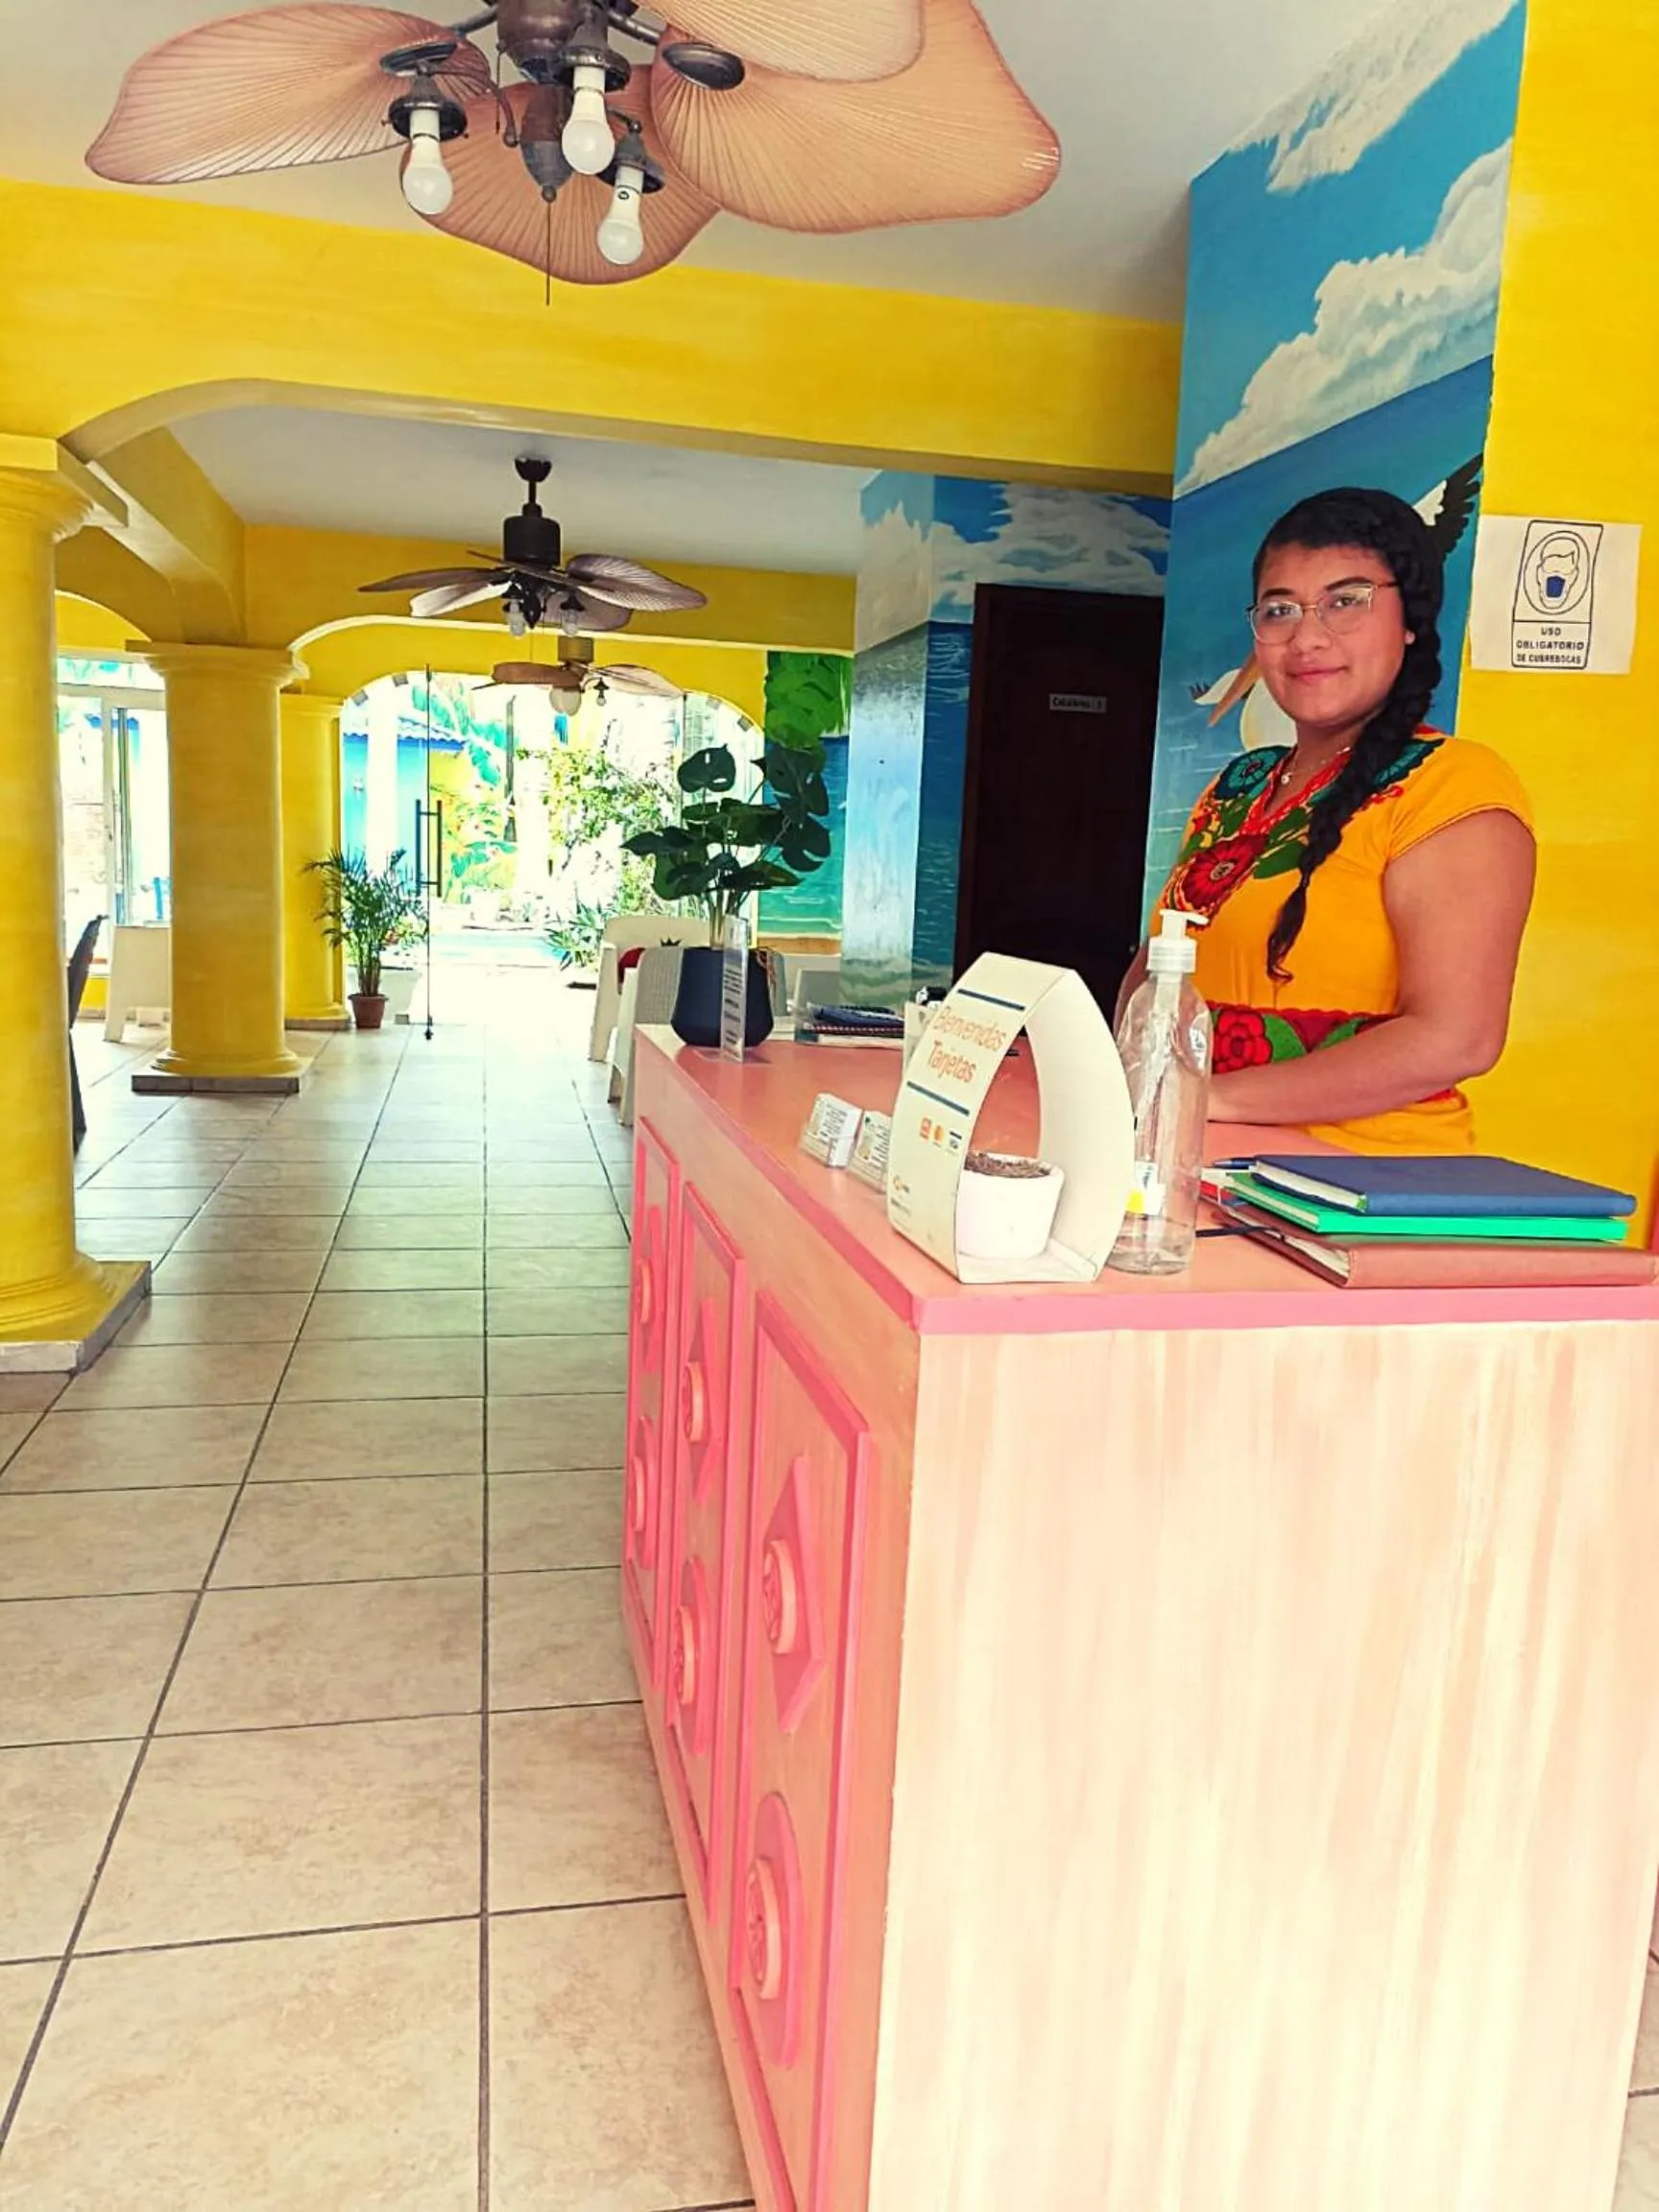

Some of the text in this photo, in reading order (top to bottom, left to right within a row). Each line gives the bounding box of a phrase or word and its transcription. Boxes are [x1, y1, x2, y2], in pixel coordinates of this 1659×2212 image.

[1541, 627, 1561, 636] USO
[1516, 640, 1584, 650] OBLIGATORIO
[1517, 653, 1581, 664] DE CUBREBOCAS
[927, 1040, 976, 1084] Tarjetas
